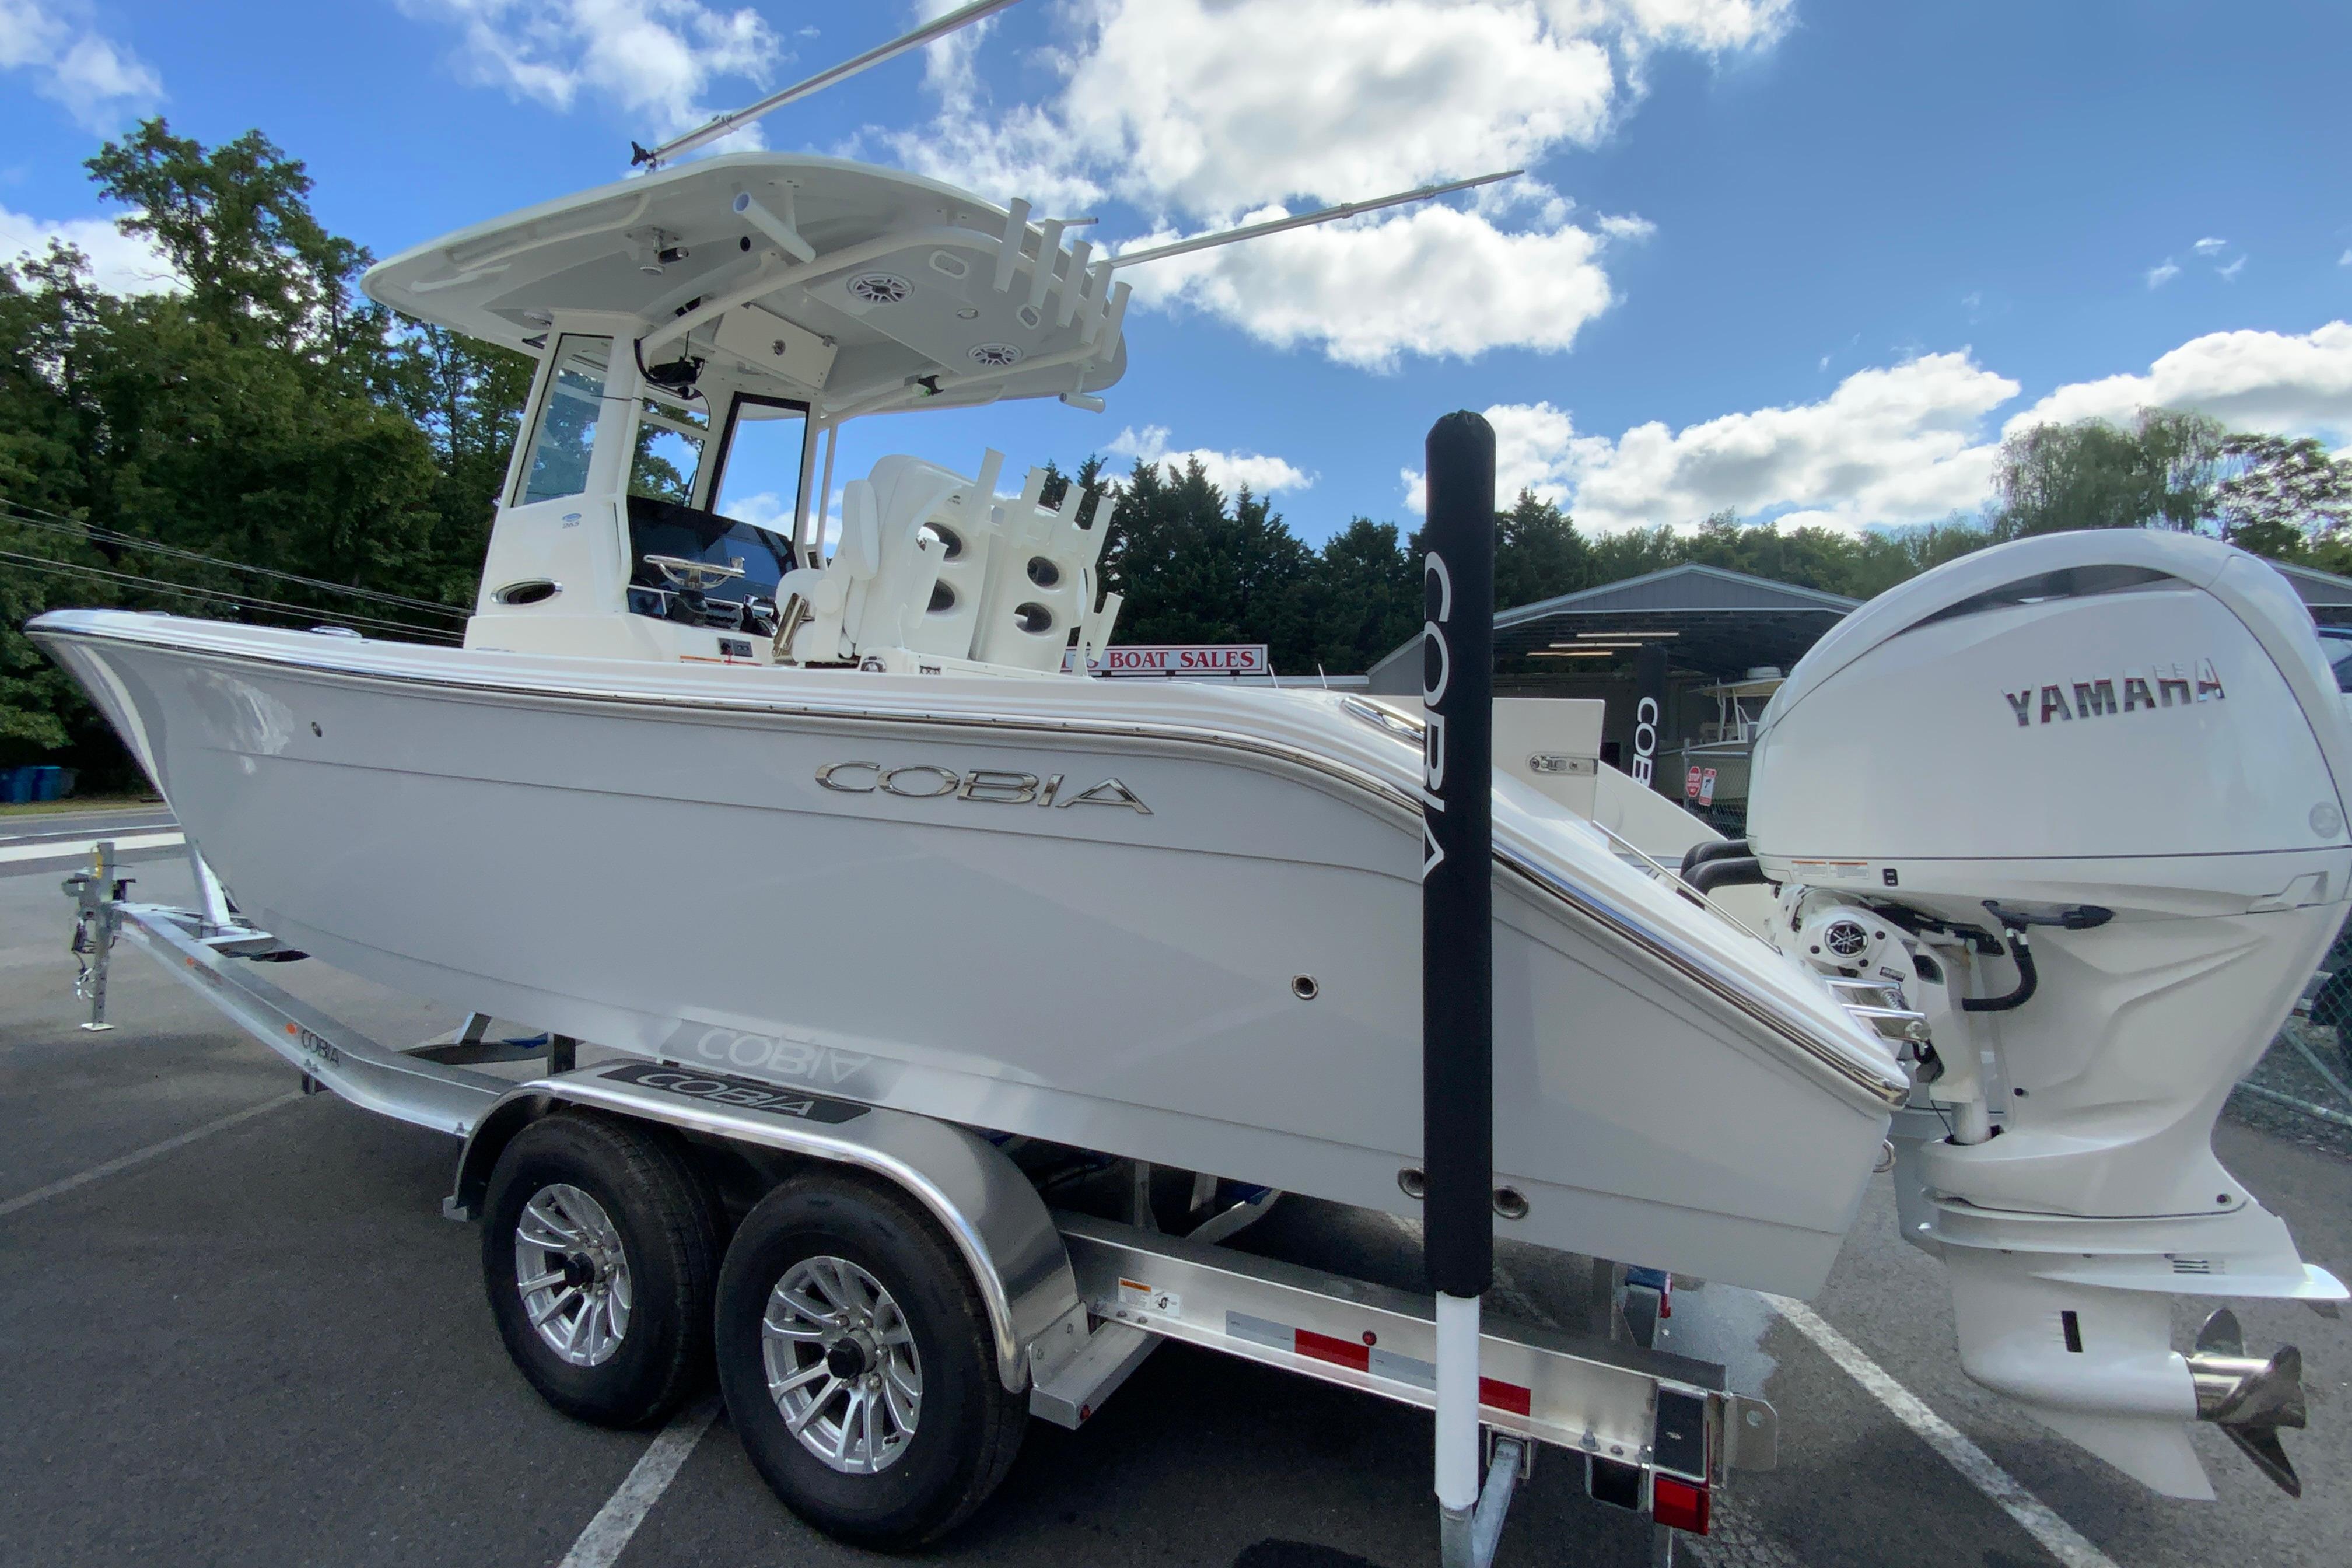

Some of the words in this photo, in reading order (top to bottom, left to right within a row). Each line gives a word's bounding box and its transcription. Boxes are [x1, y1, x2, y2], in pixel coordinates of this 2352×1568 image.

[1110, 651, 1169, 668] BOAT
[1180, 650, 1254, 667] SALES
[2001, 658, 2226, 727] YAMAHA
[815, 761, 1154, 815] COBIA
[301, 1029, 340, 1068] COBIA
[636, 1073, 815, 1117] COBIA
